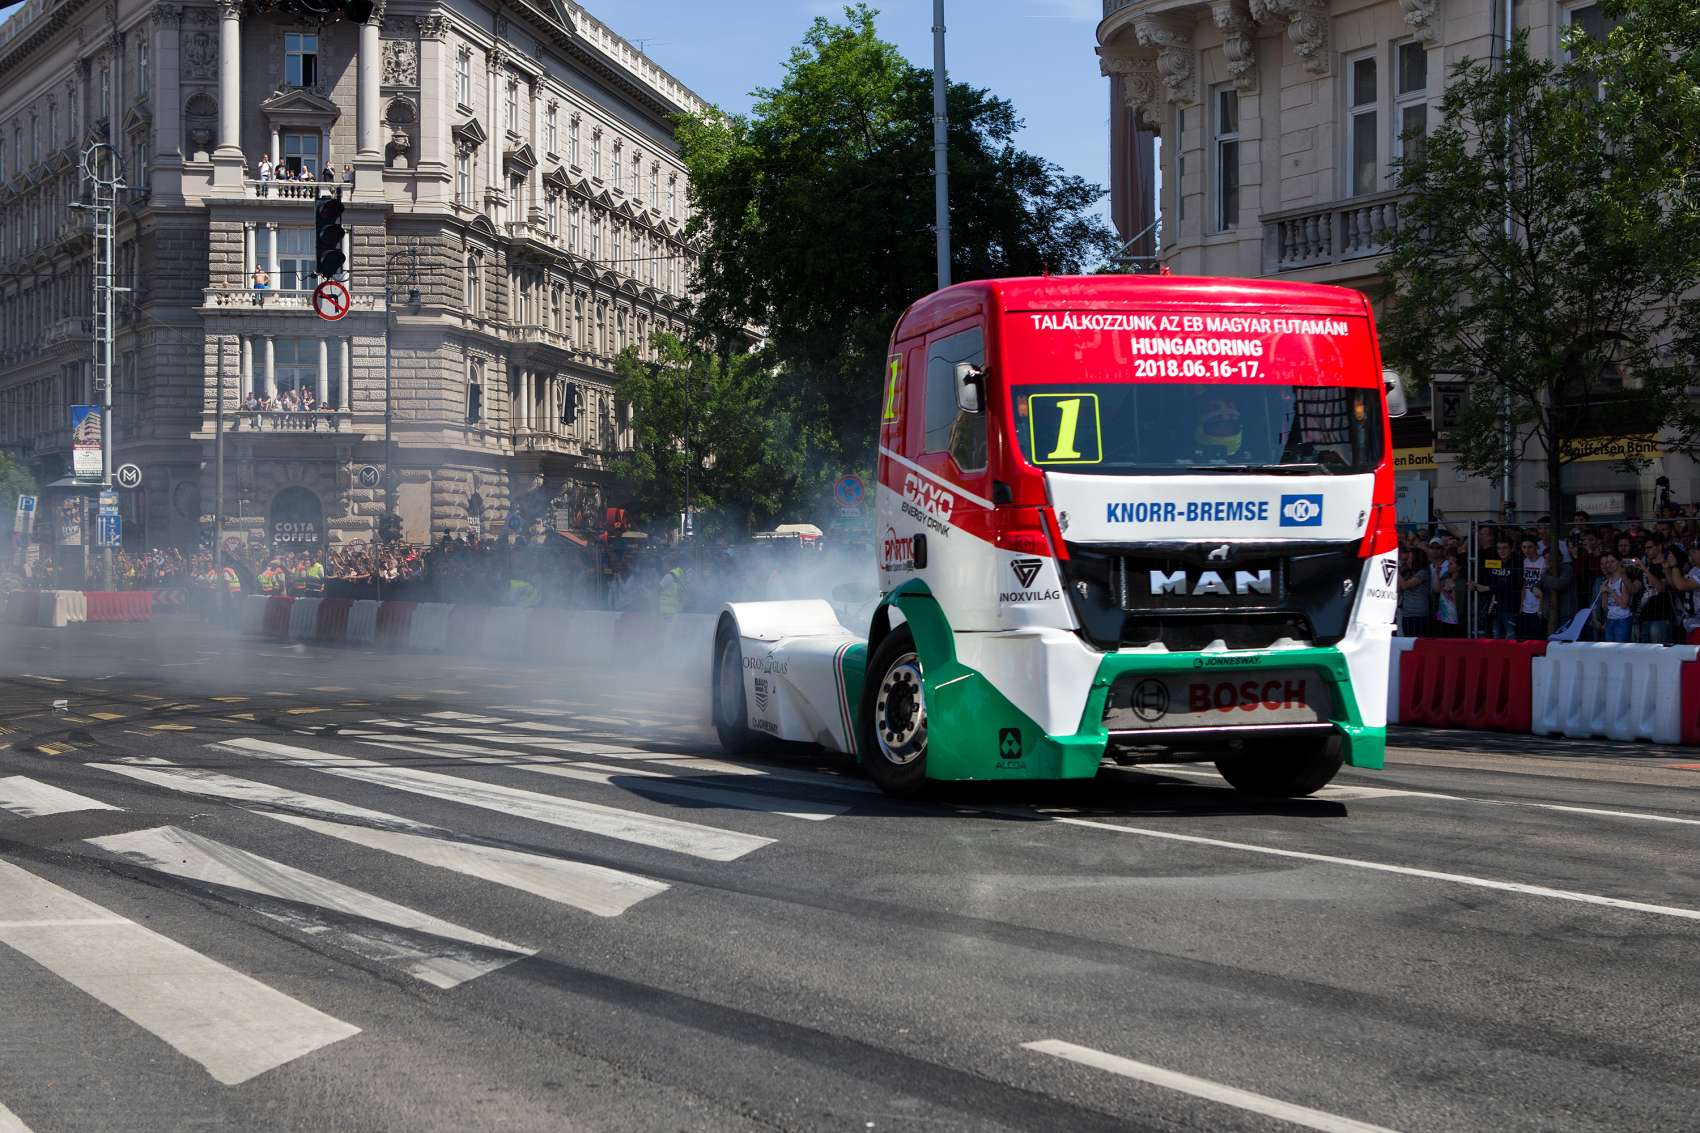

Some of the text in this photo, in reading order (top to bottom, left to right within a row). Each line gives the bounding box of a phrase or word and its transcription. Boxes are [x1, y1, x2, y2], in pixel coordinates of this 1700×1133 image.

[1031, 312, 1349, 336] TALÁLKOZZUNK AZ EB MAGYAR FUTAMÁN!
[1131, 338, 1263, 356] HUNGARORING
[1134, 360, 1265, 378] 2018.06.16-17.
[884, 359, 898, 418] 1
[1047, 398, 1081, 459] 1
[1627, 441, 1658, 454] Bank
[1408, 453, 1434, 465] Bank
[901, 502, 950, 538] ENERGY DRINK
[1106, 501, 1269, 523] KNORR-BREMSE
[275, 522, 314, 532] COSTA
[273, 533, 319, 542] COFFEE
[1149, 569, 1272, 595] MAN
[999, 588, 1061, 602] INOXVILÁG
[1187, 680, 1306, 714] BOSCH
